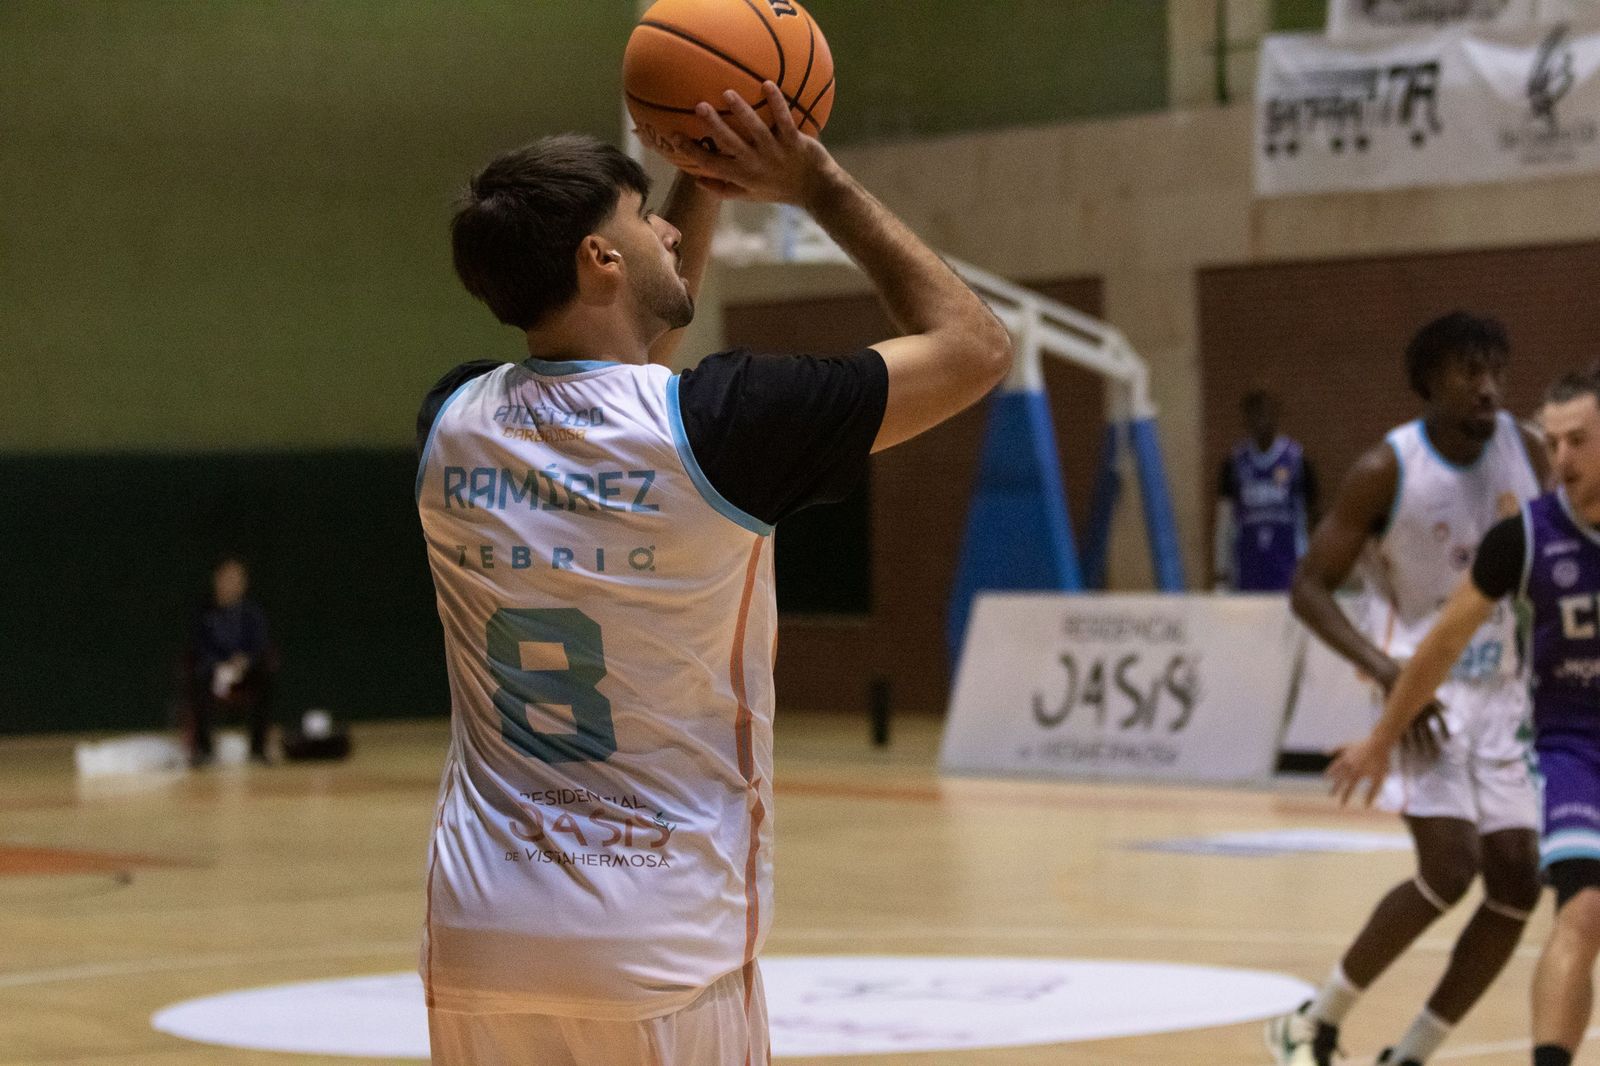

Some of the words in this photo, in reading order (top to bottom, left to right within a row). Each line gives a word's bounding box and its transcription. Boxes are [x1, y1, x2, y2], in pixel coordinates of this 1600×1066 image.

[443, 463, 660, 512] RAMÍREZ
[456, 545, 656, 571] TEBRIO
[486, 607, 618, 764] 8
[520, 788, 646, 810] ESIDENIAL
[504, 852, 519, 862] DE
[525, 848, 671, 868] VISTAHERMOSA
